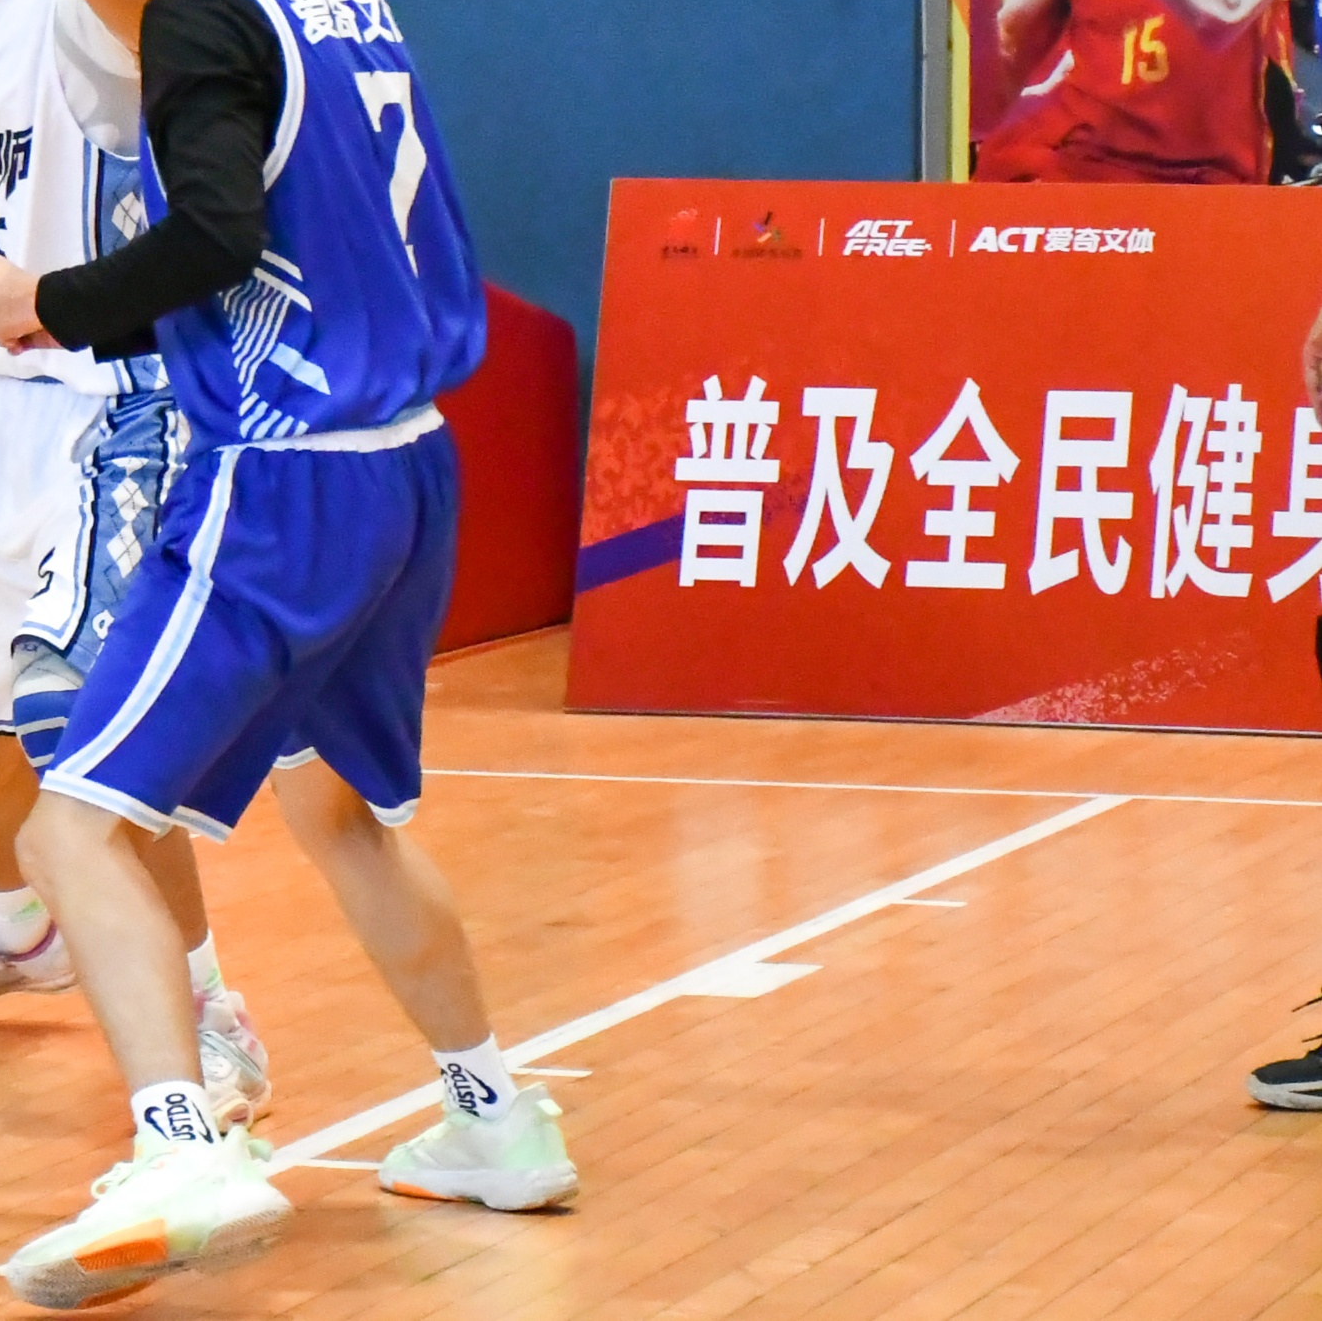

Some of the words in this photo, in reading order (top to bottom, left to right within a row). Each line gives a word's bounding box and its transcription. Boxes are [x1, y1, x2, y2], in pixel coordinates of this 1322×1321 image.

[1120, 14, 1170, 85] 15
[353, 71, 427, 279] 7
[842, 238, 929, 257] FREE
[845, 219, 913, 238] ACT
